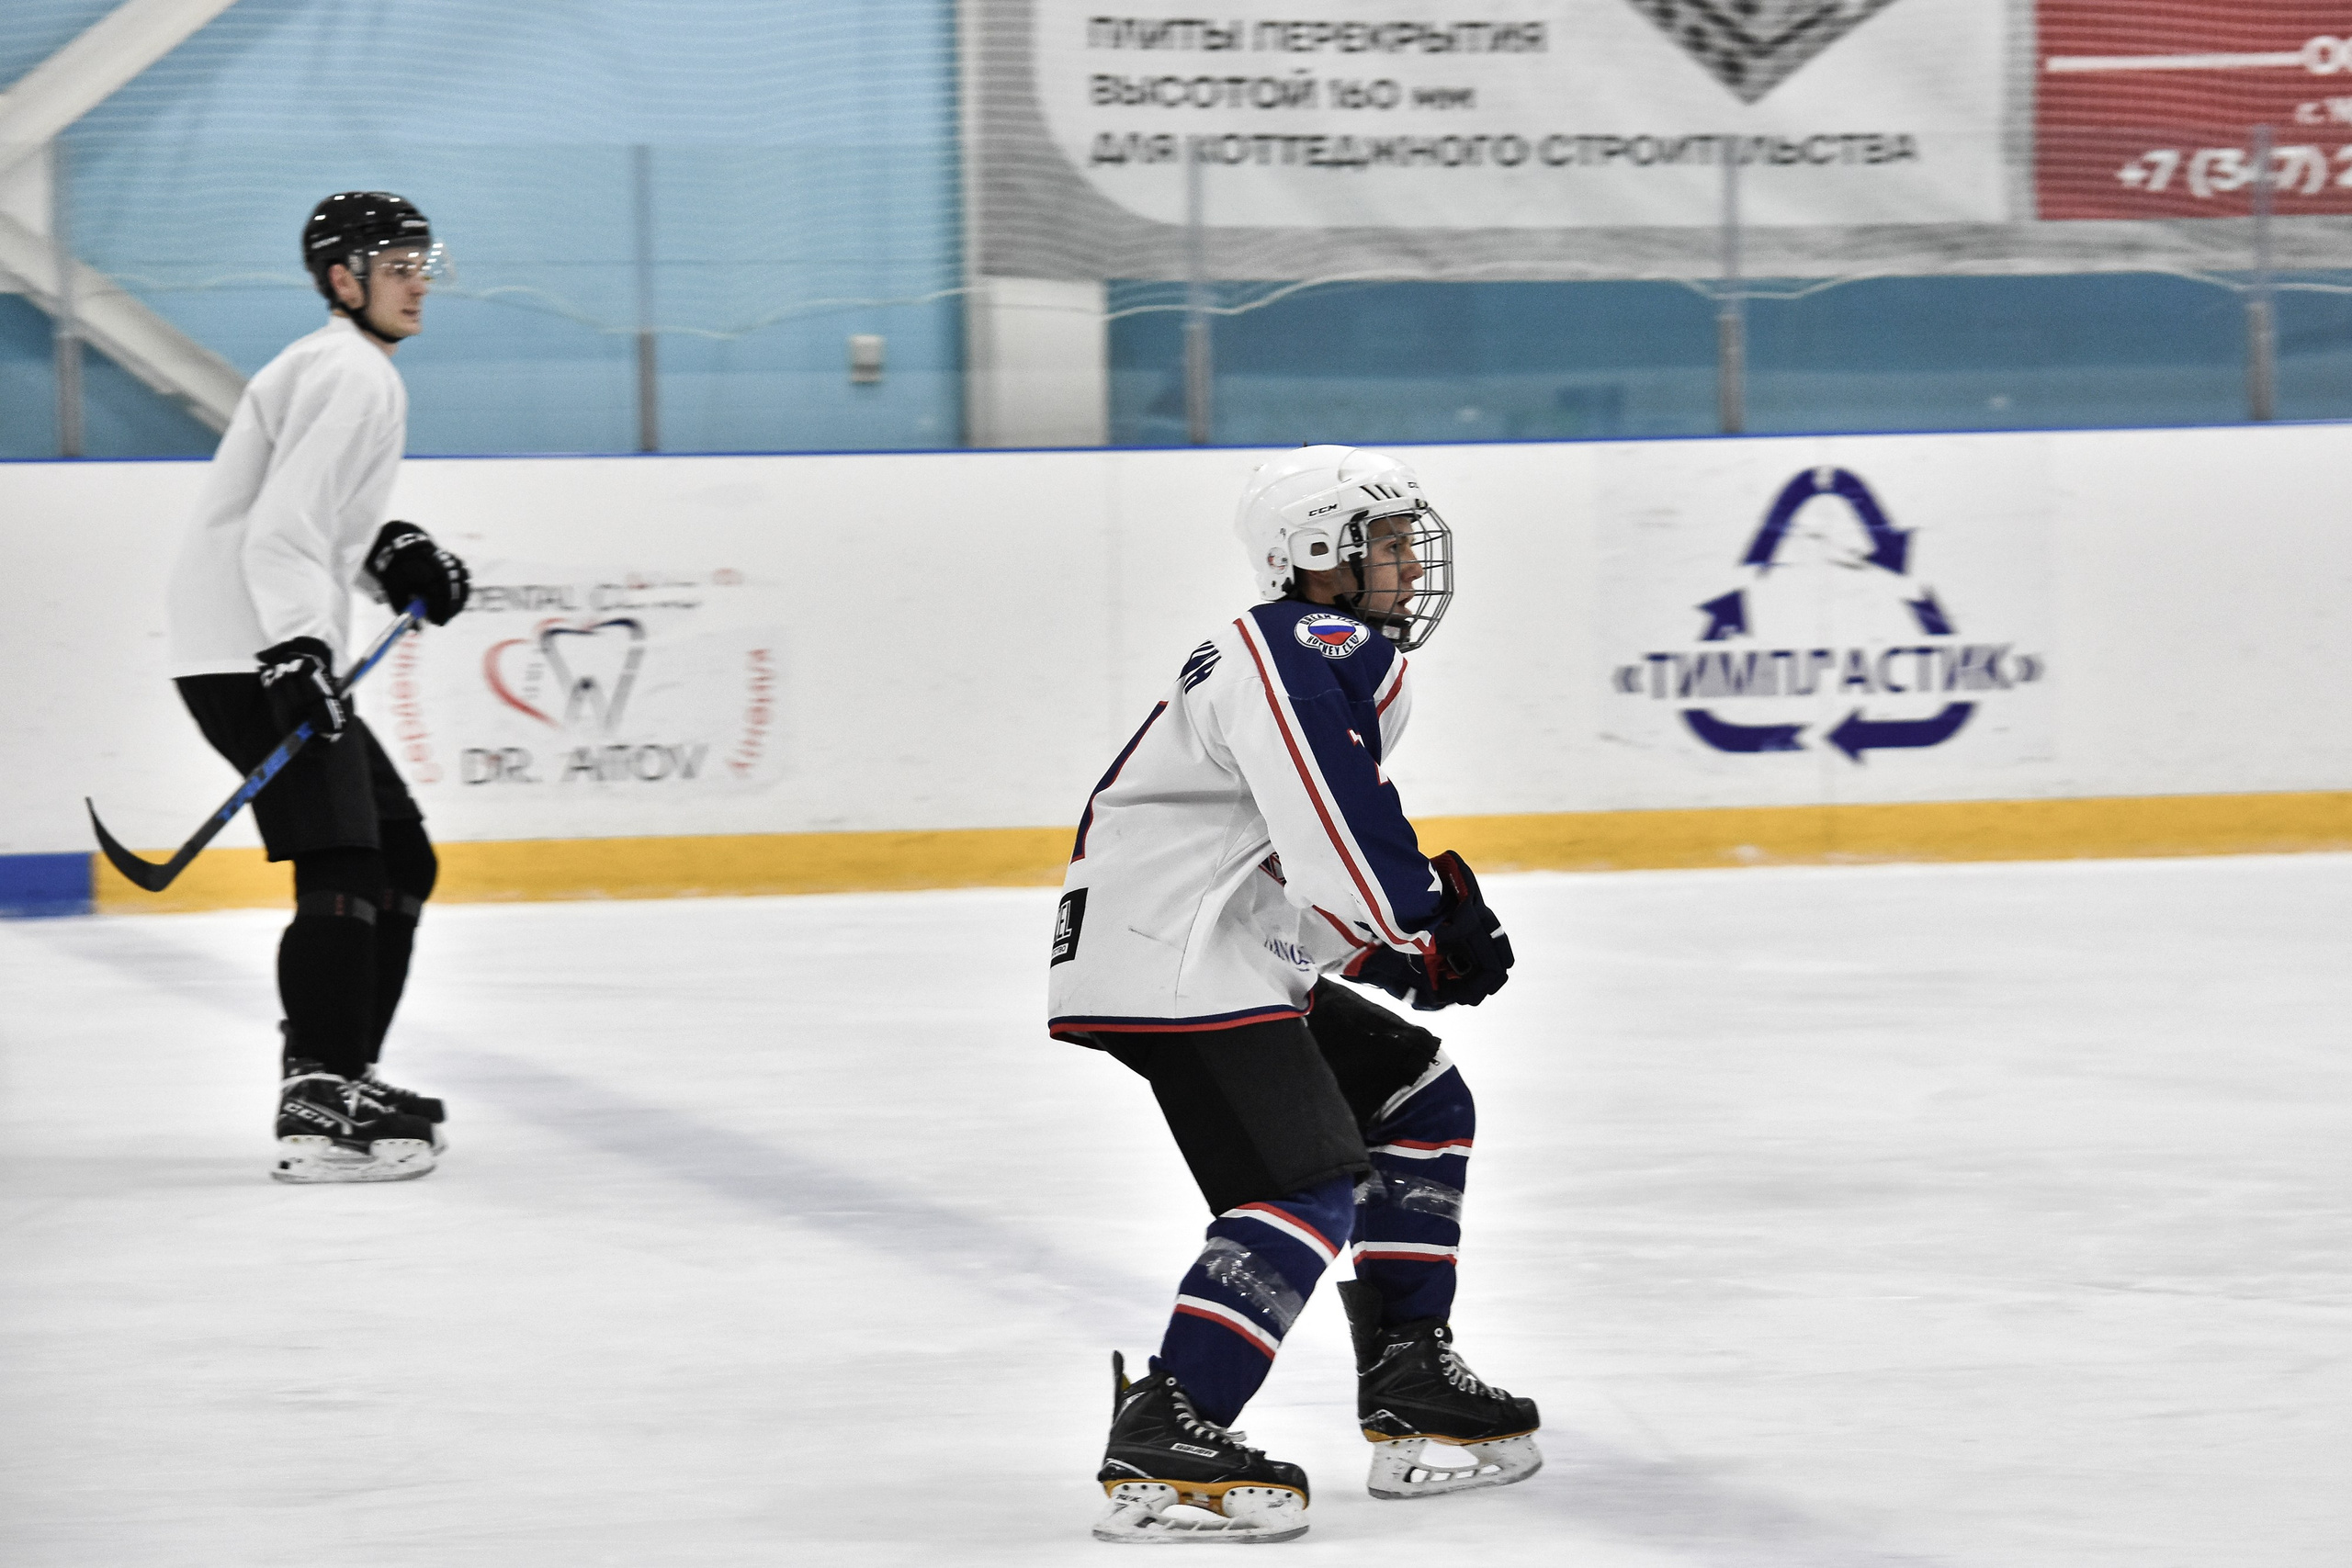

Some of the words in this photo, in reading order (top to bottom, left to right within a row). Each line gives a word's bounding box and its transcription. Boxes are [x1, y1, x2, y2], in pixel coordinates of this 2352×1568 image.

[1088, 16, 1243, 51] ПЛИТЫ
[1252, 20, 1548, 53] ПЕРЕКРЫТИЯ
[1091, 67, 1318, 109] ВЫСОТОЙ
[1328, 78, 1402, 109] 160
[1089, 132, 1179, 167] ДЛЯ
[1308, 503, 1338, 517] CCM
